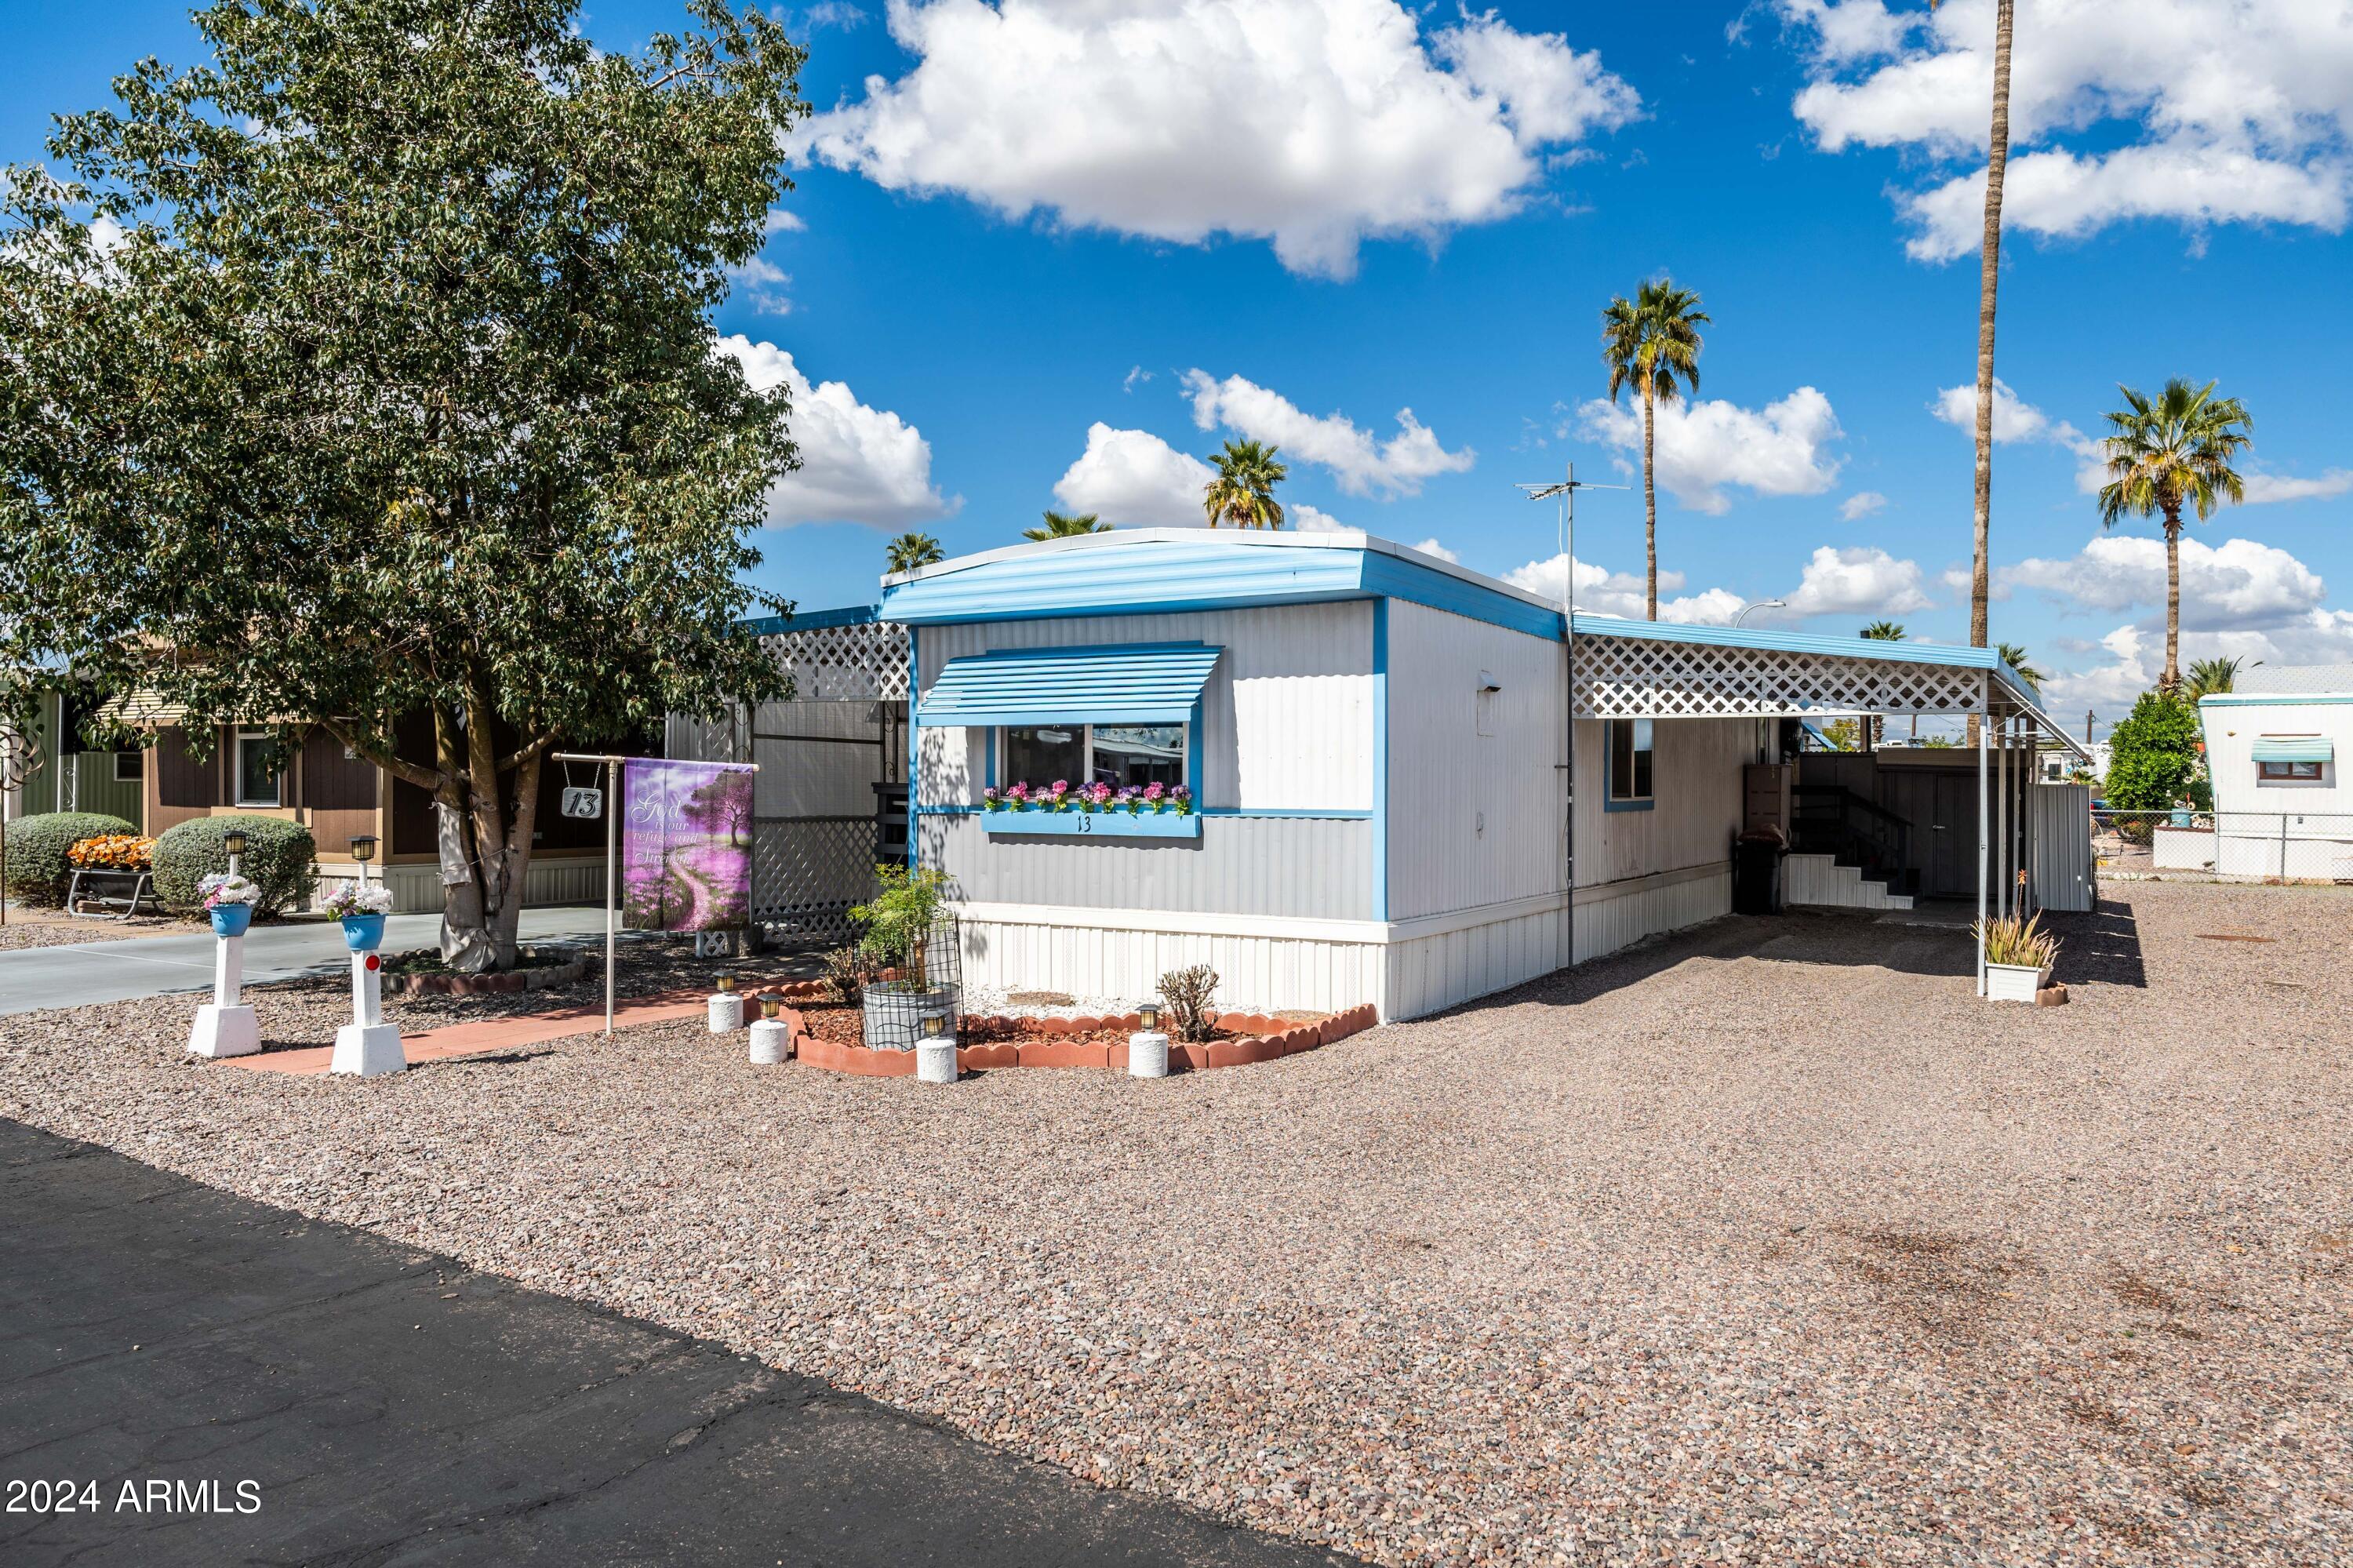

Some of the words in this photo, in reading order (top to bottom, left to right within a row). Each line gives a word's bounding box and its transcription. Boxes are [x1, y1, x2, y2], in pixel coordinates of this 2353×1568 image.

[567, 791, 598, 817] 13
[631, 789, 682, 823] God
[655, 818, 664, 829] is
[668, 822, 689, 831] our
[1078, 815, 1092, 832] 13
[633, 830, 671, 845] refuge
[675, 832, 698, 843] and
[635, 844, 691, 867] Strength
